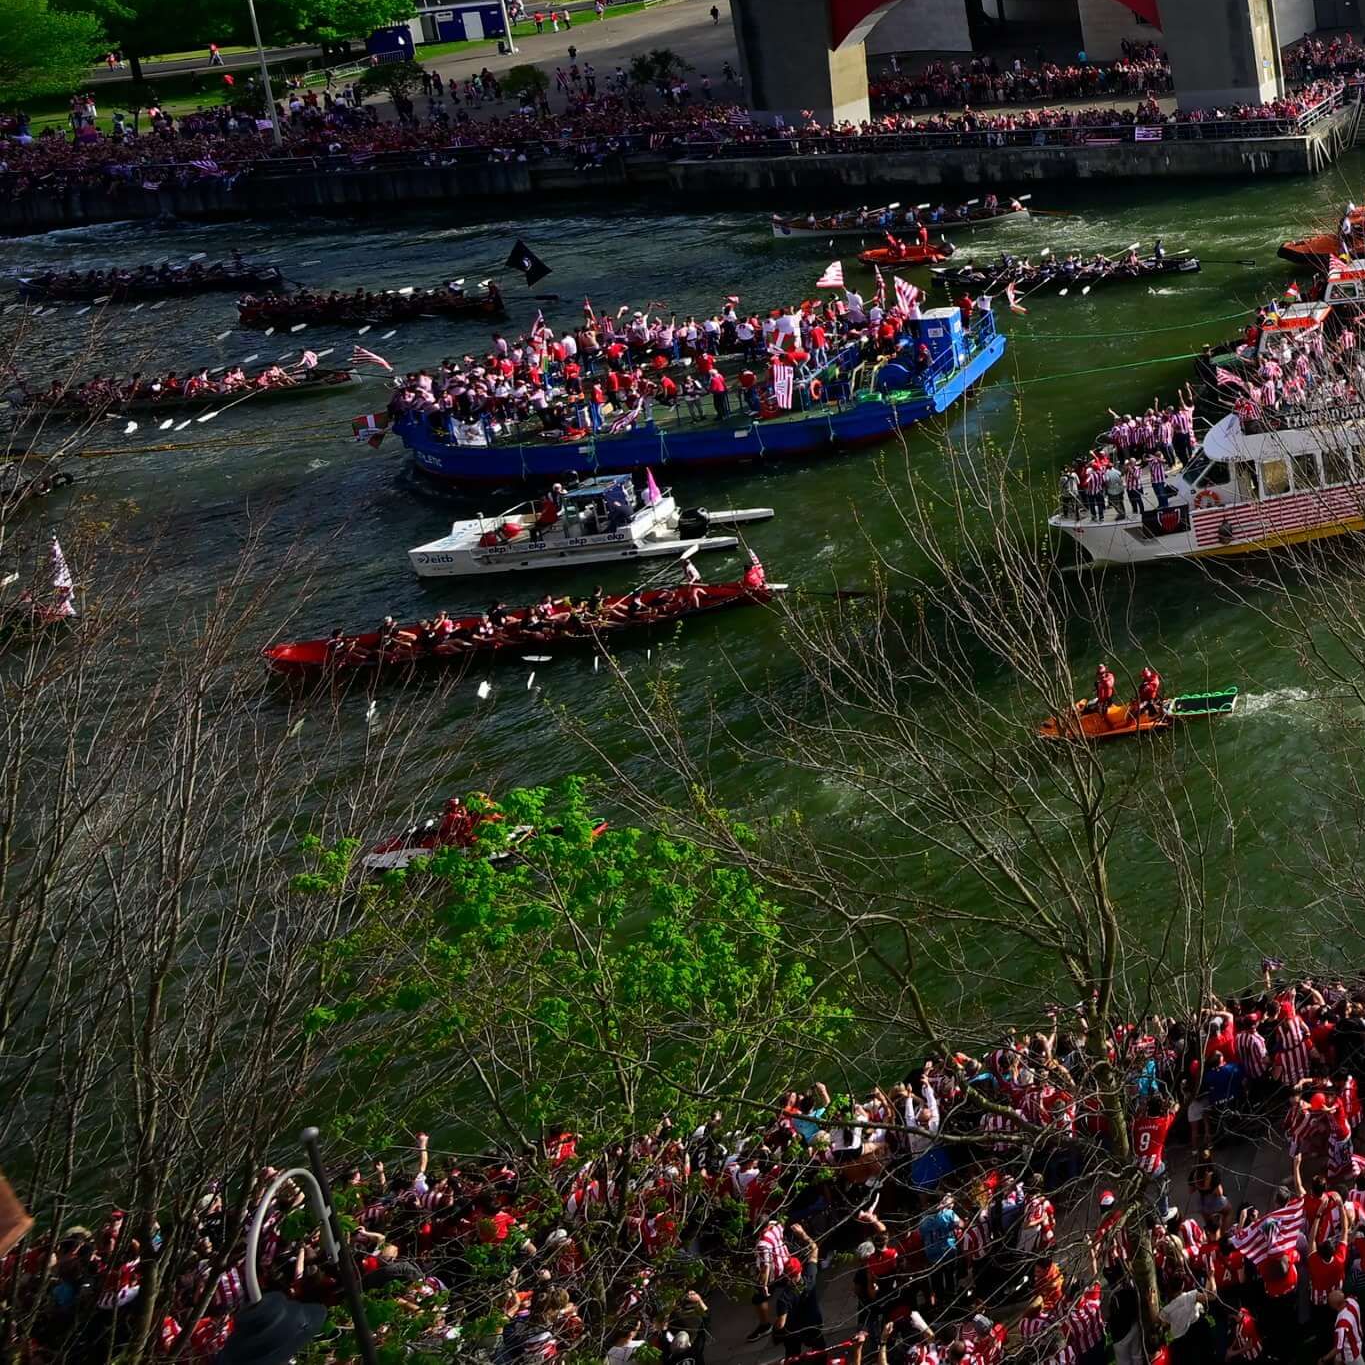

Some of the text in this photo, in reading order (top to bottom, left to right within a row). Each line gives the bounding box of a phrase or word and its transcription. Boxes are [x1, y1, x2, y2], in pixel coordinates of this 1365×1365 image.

[607, 532, 625, 541] ekp
[569, 537, 588, 546] ekp
[488, 546, 506, 555] ekp
[528, 542, 547, 551] ekp
[431, 553, 454, 564] eitb
[1139, 1132, 1151, 1152] 9
